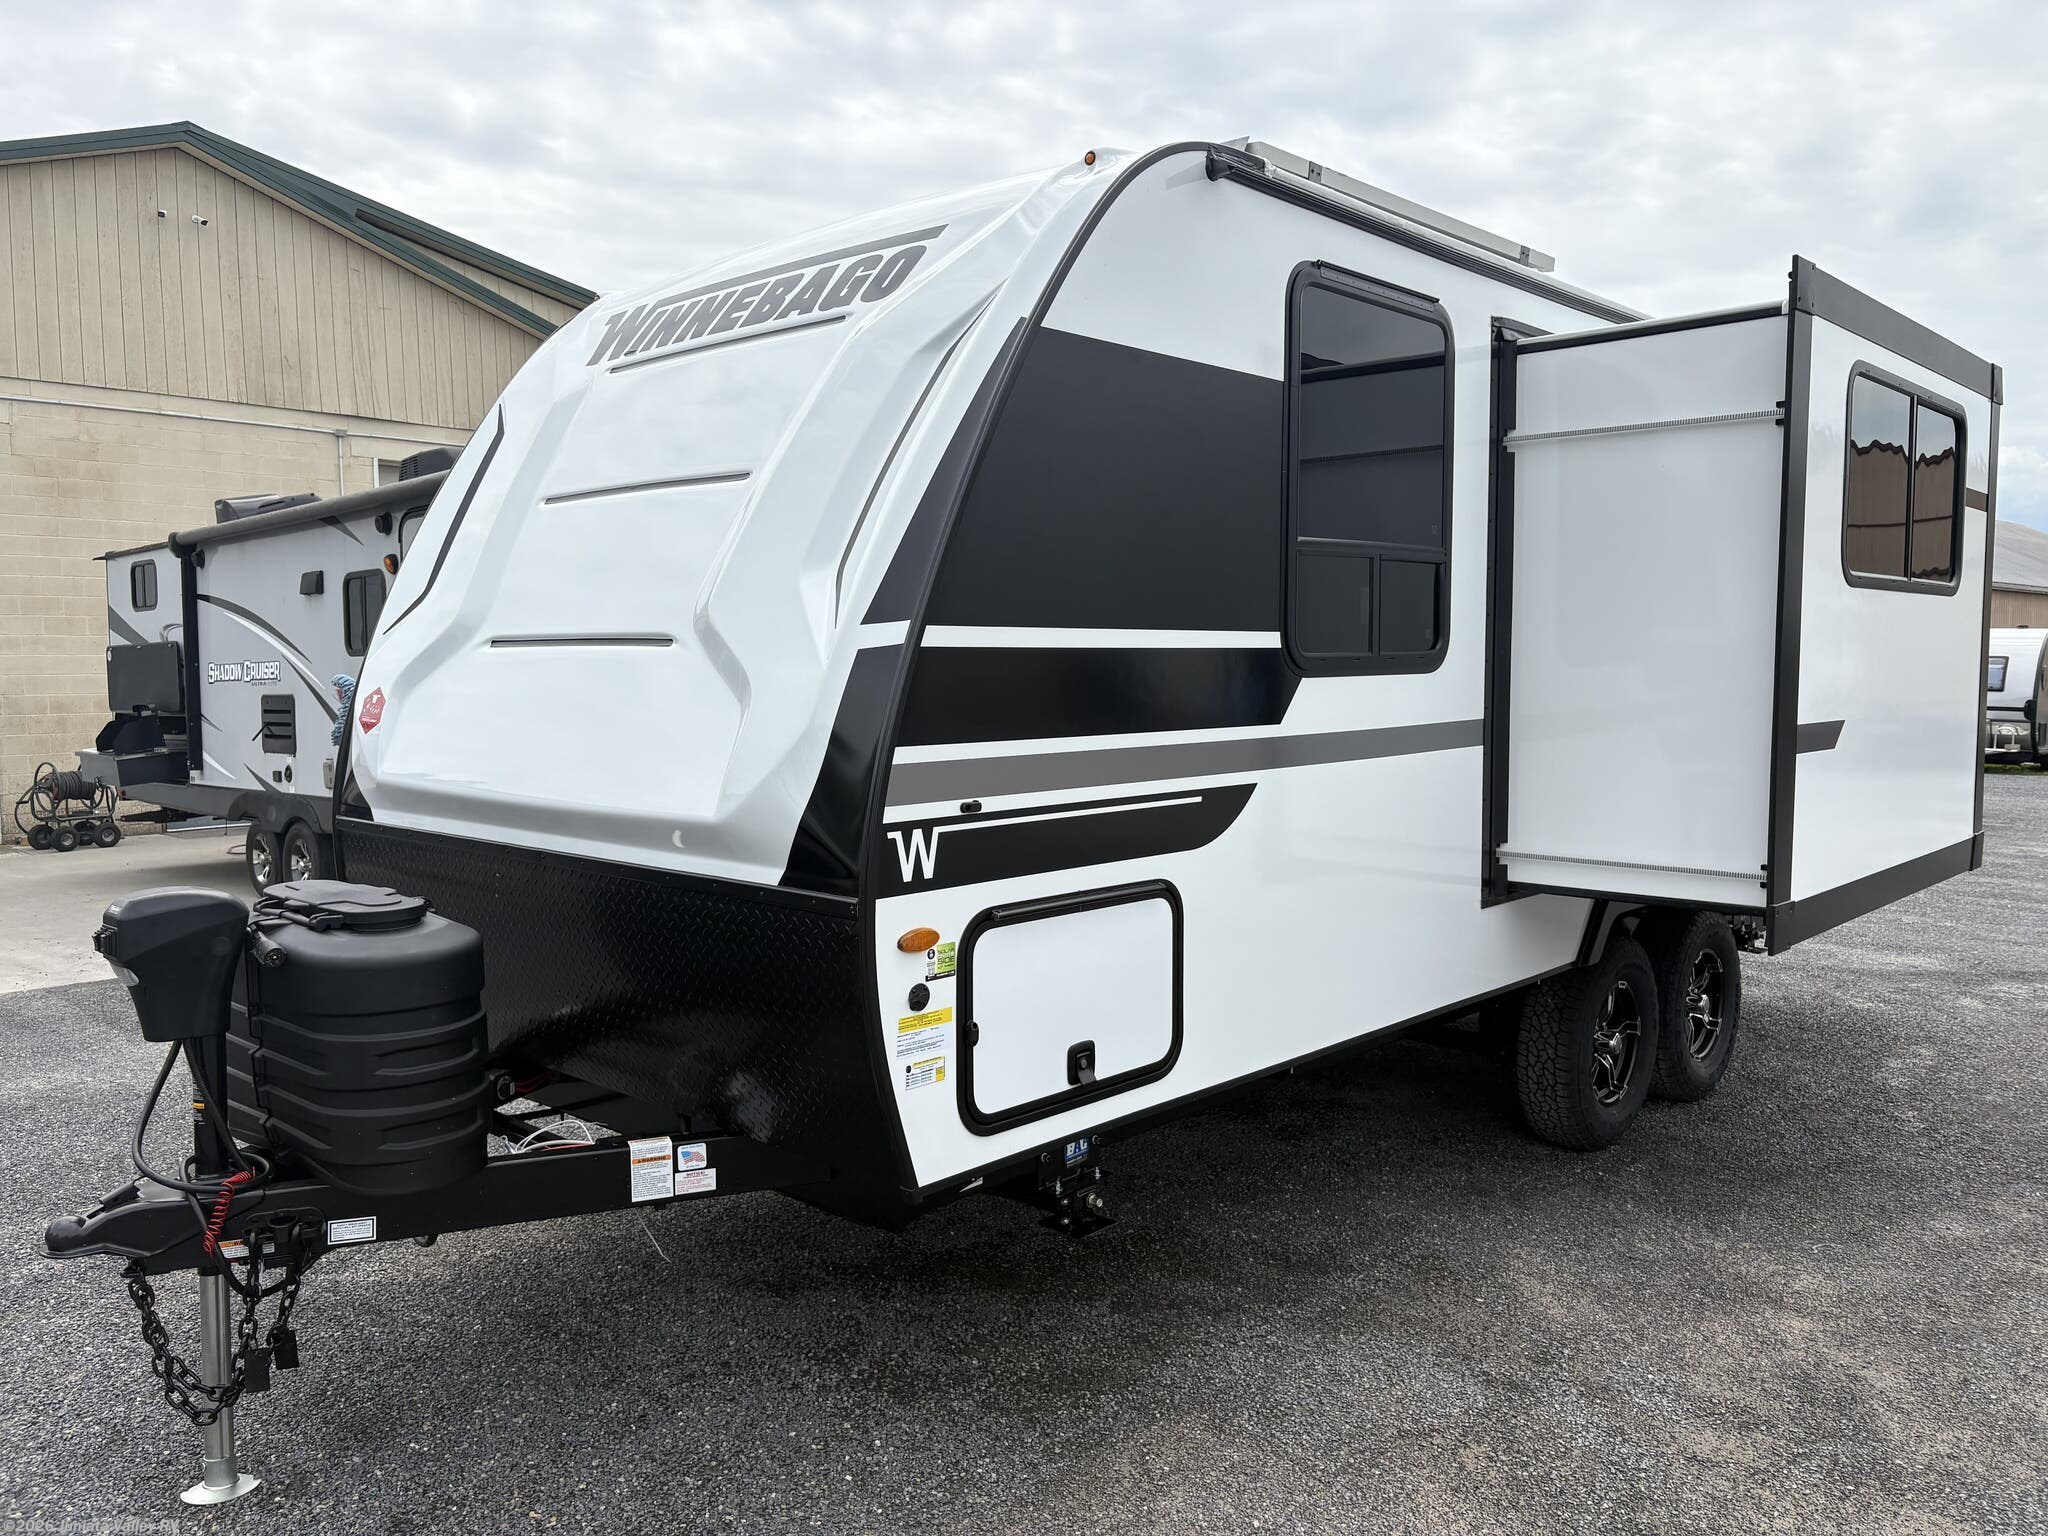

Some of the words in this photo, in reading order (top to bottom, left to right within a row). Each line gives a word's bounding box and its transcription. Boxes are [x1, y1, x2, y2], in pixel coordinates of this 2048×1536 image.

[585, 245, 927, 366] WINNEBAGO
[208, 662, 243, 684] SHADOW
[244, 660, 281, 682] CRUISER
[886, 827, 940, 883] W
